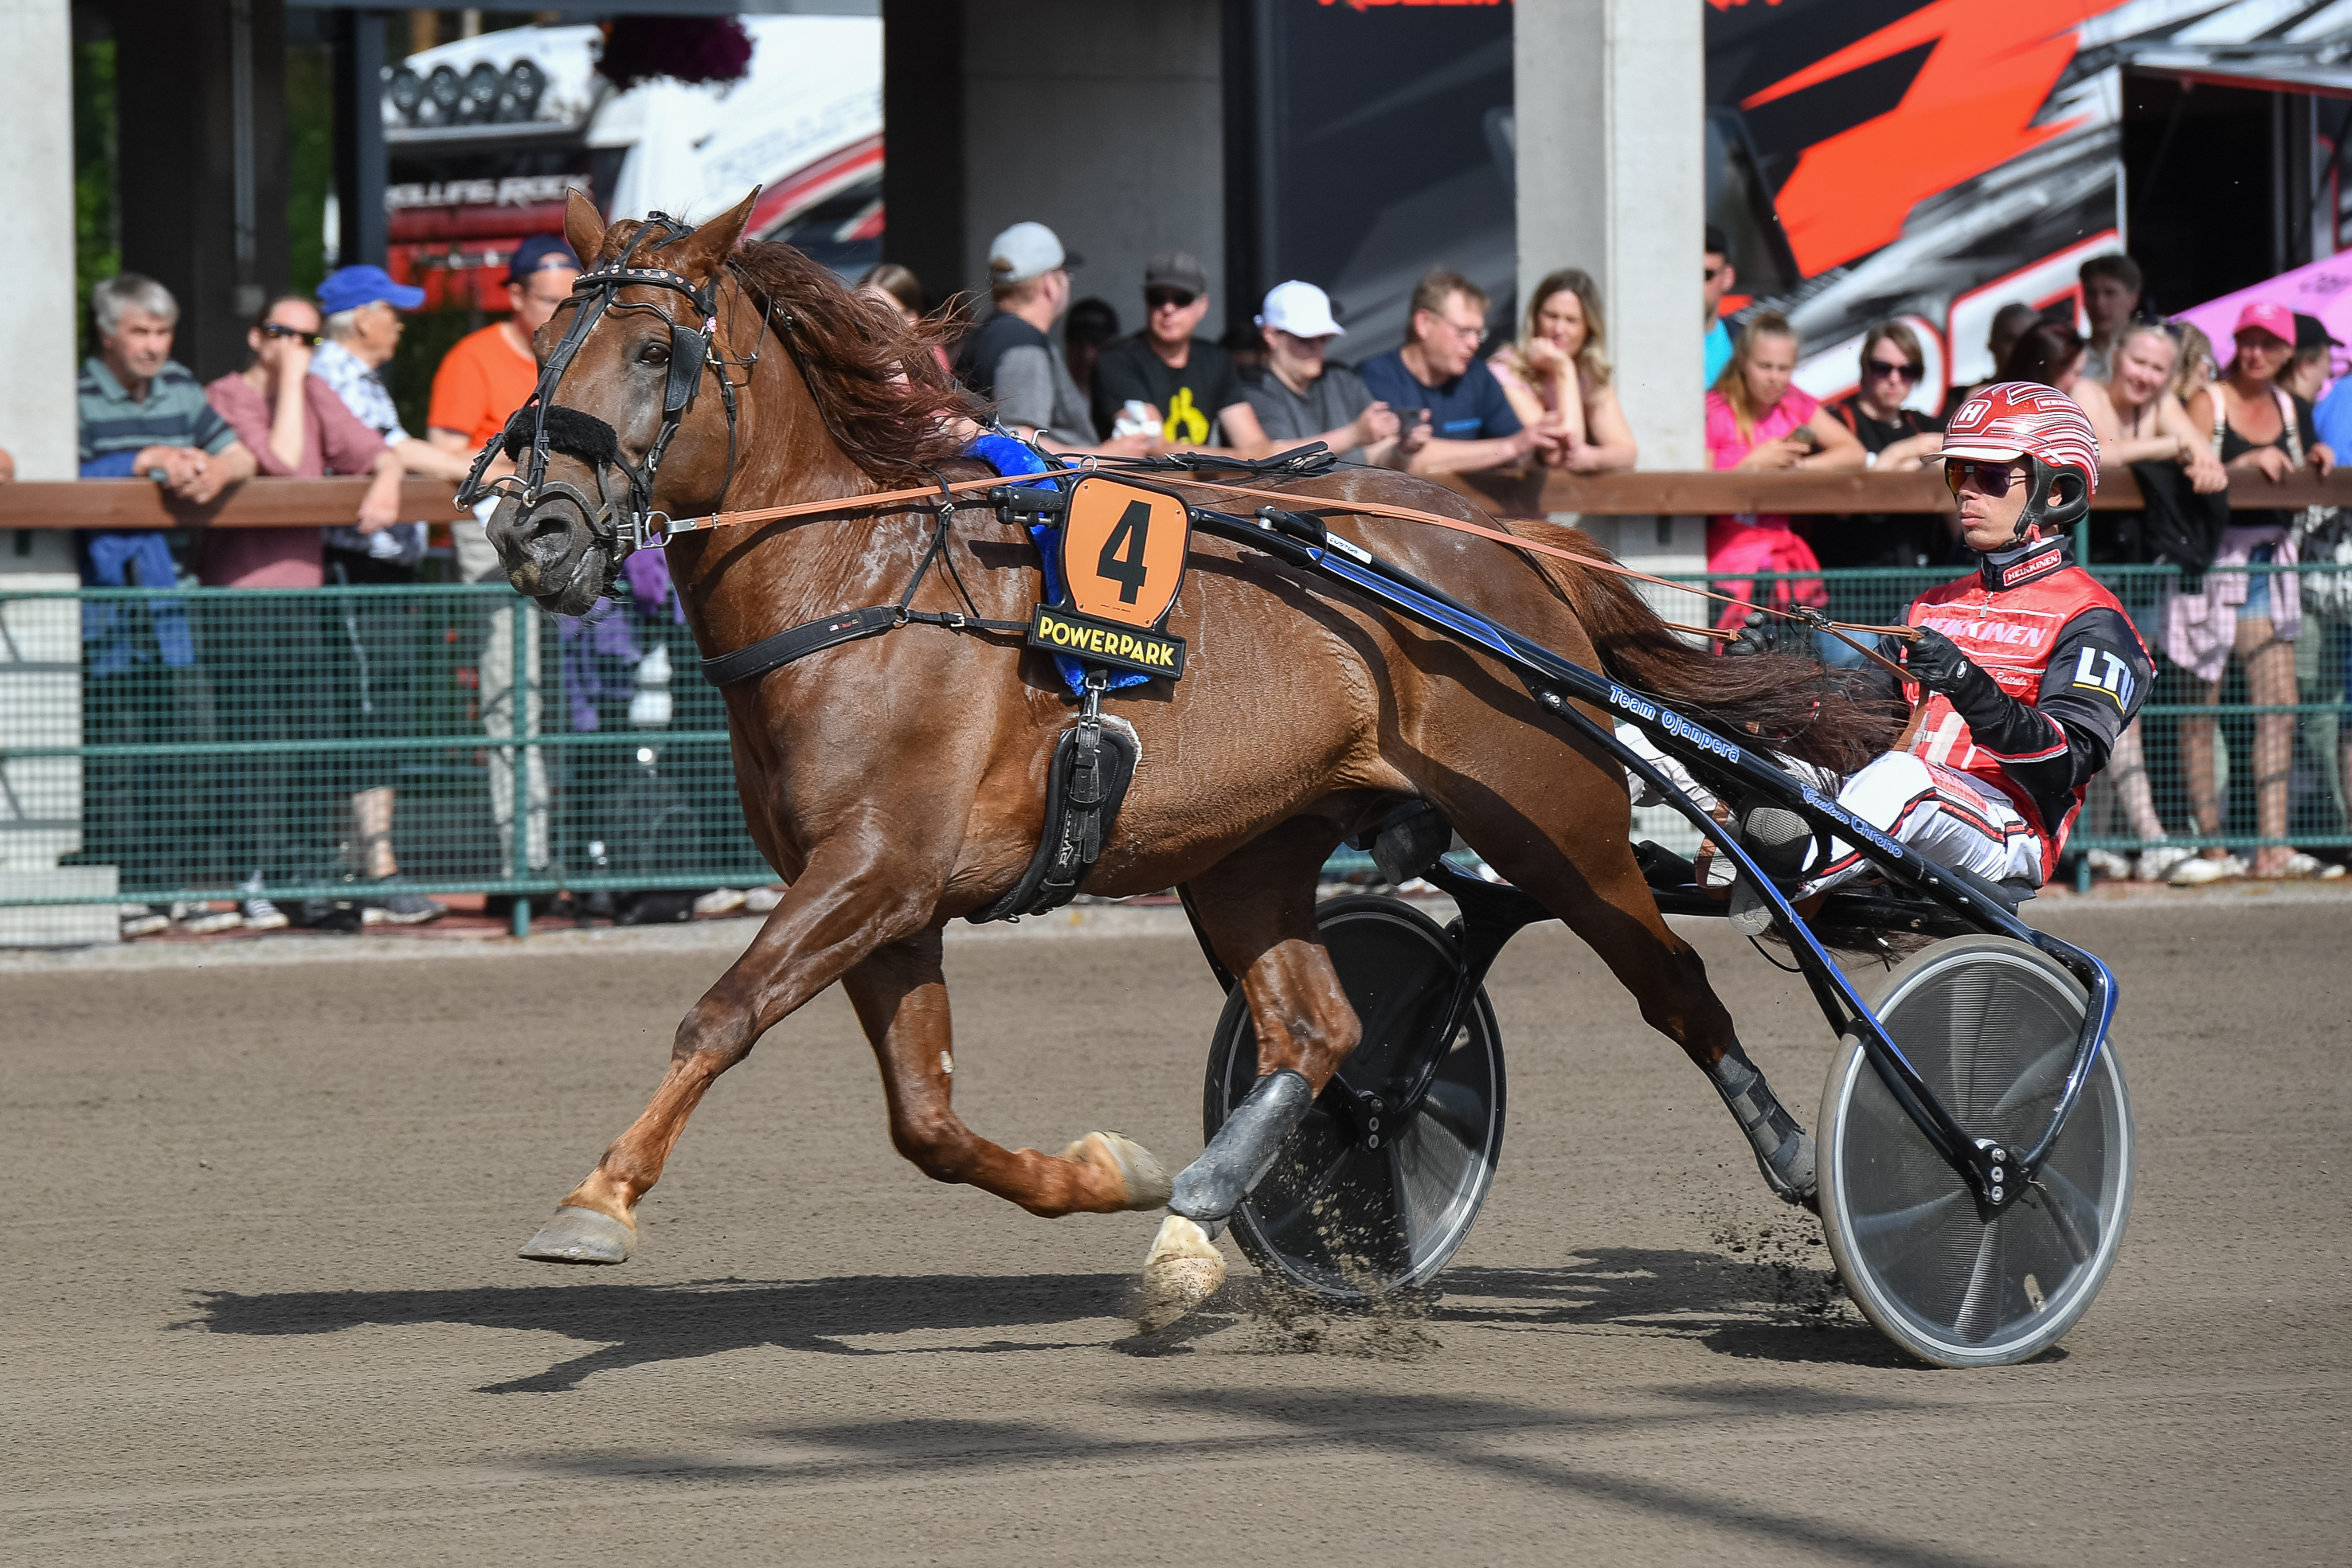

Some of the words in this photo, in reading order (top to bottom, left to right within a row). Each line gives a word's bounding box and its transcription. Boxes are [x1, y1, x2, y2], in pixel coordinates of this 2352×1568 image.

[1958, 404, 1983, 422] H
[1096, 499, 1153, 605] 4
[2007, 554, 2059, 580] HEIKKINEN
[1039, 616, 1175, 667] POWERPARK
[2074, 646, 2135, 711] LTU
[1609, 685, 1656, 721] Team
[1661, 710, 1740, 764] Ojanperä
[1800, 783, 1850, 824] Custom
[1851, 815, 1904, 858] Chrono
